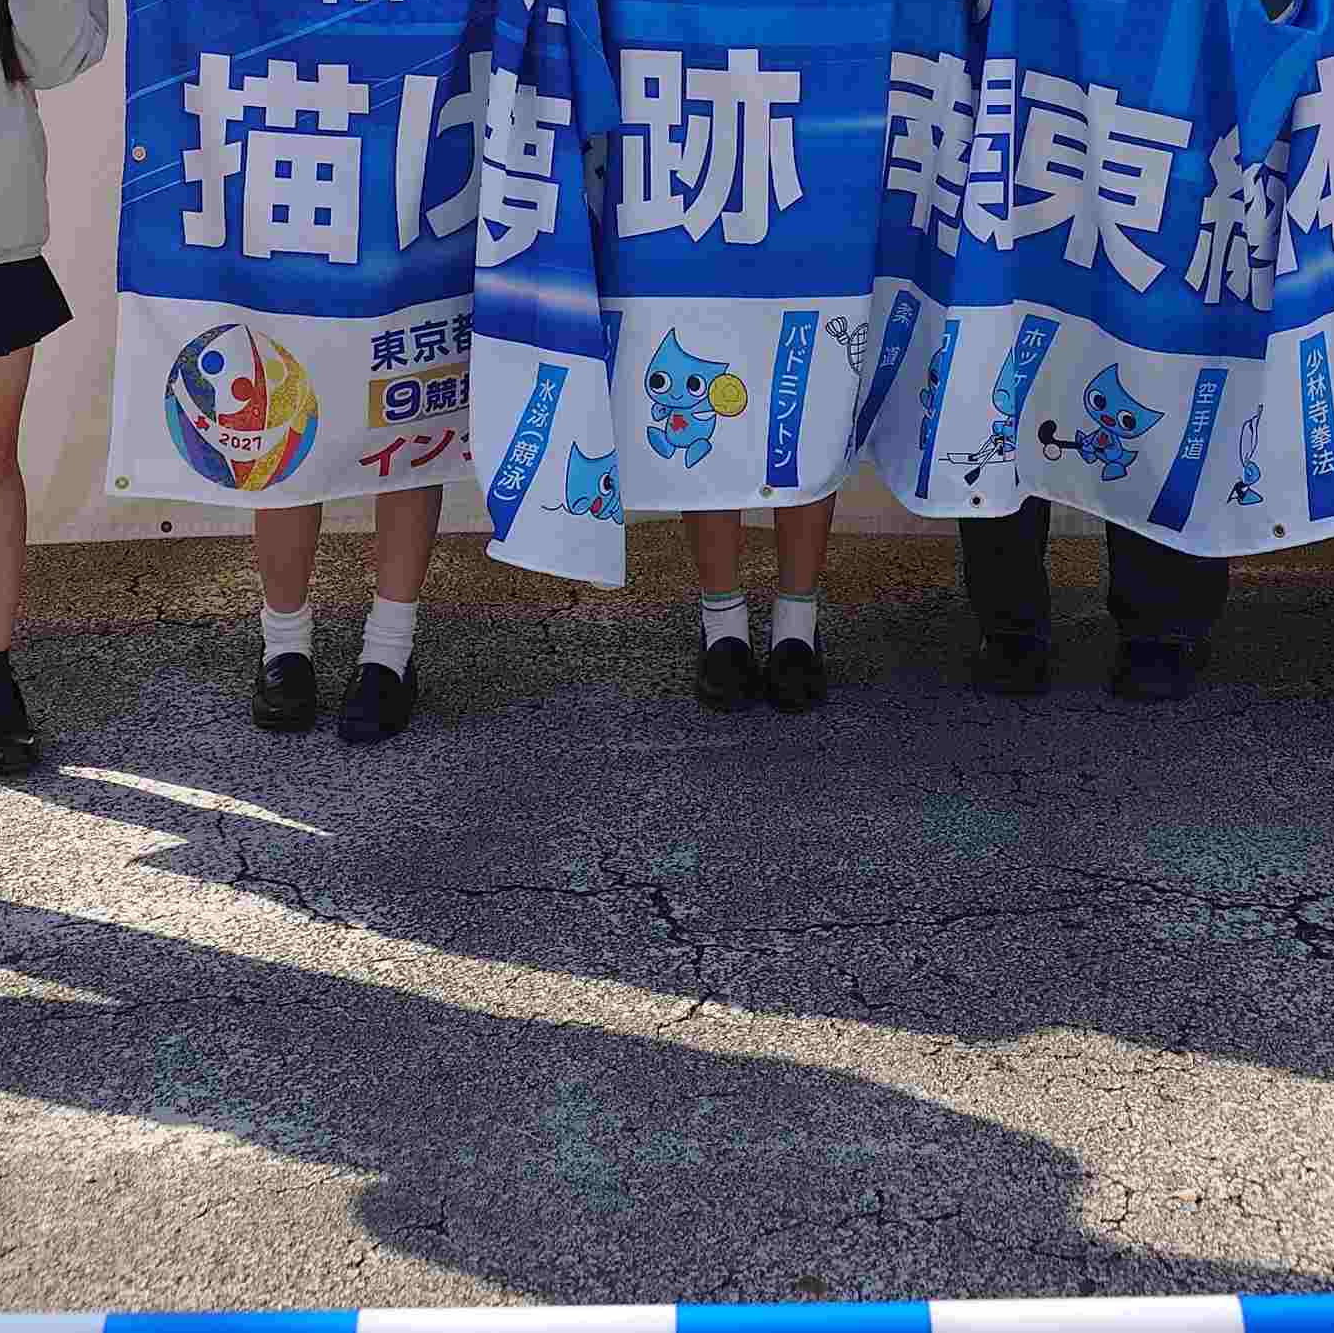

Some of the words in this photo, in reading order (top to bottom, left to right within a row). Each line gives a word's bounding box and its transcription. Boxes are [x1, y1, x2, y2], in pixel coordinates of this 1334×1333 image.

[773, 322, 812, 468] バドミントン
[1181, 381, 1218, 460] 空手道
[218, 432, 263, 452] 2027
[359, 428, 472, 476] イン
